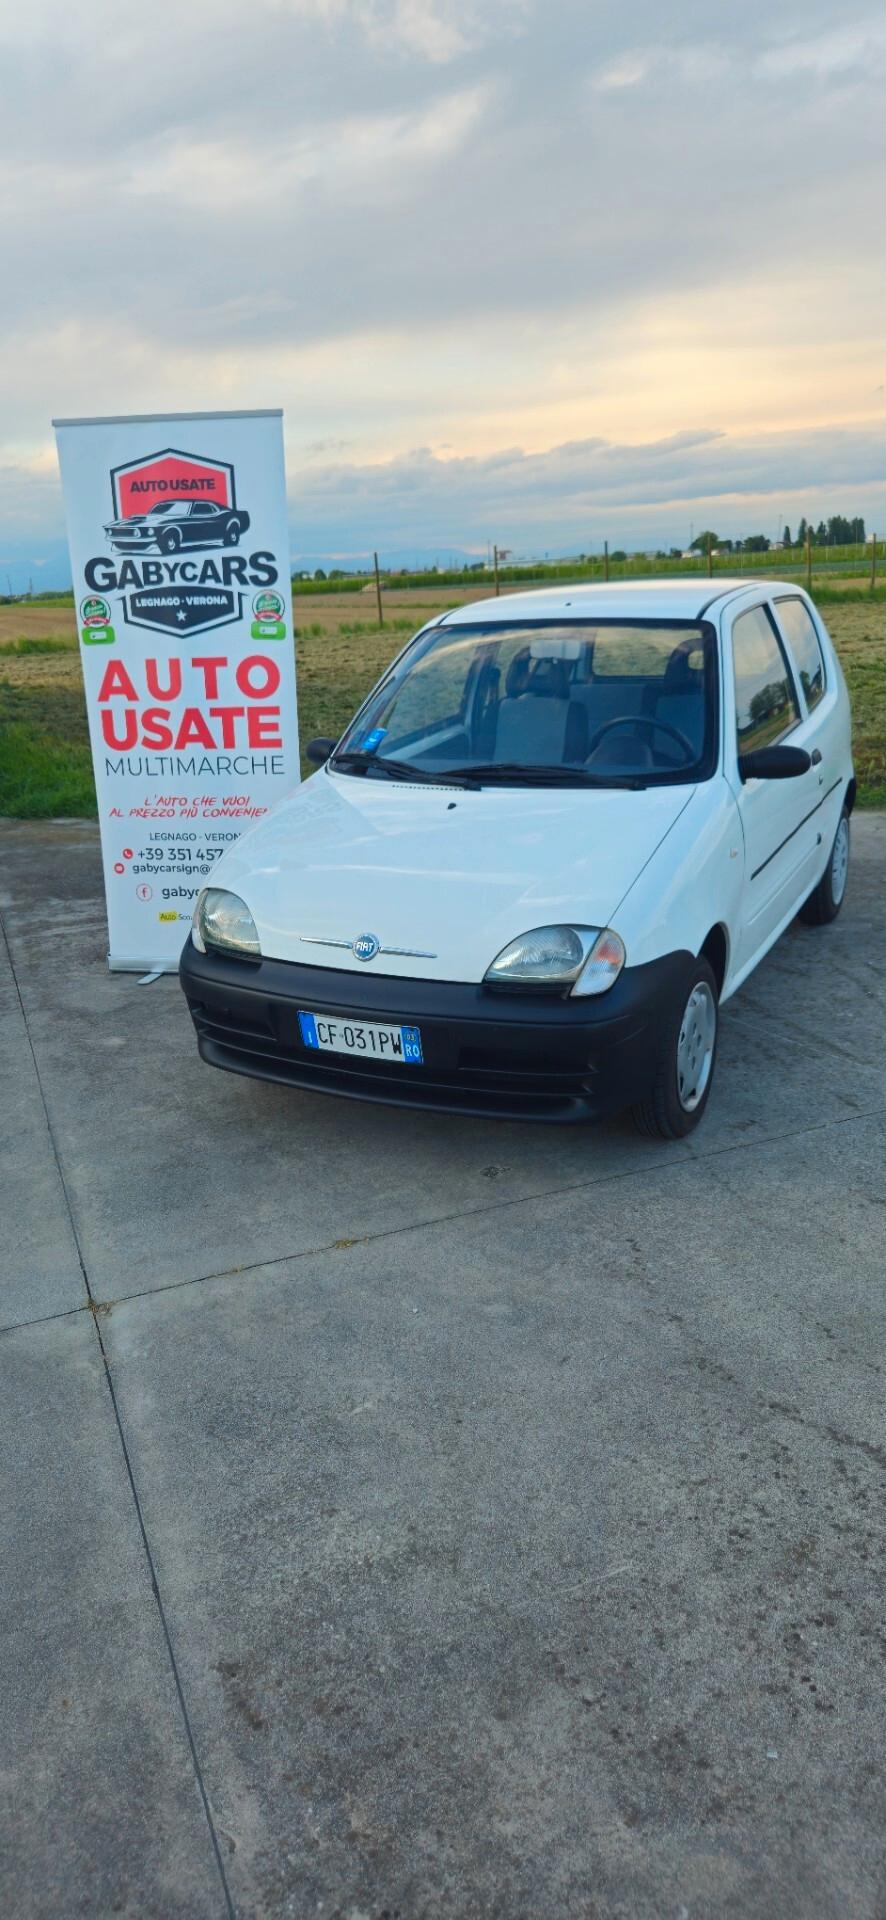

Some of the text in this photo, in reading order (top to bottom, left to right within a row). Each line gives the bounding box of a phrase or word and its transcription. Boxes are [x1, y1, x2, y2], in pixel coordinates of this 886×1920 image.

[130, 478, 216, 493] AUTO USATE
[84, 551, 279, 593] GABYCARS
[135, 597, 180, 608] LEGNAGO
[186, 595, 228, 606] VERONA
[97, 655, 281, 702] AUTO
[101, 706, 283, 751] USATE
[105, 755, 285, 776] MULTIMARCHE
[144, 795, 250, 806] L'AUTO CHE VUOI
[109, 808, 123, 817] AL
[129, 808, 175, 817] PREZZO
[180, 807, 198, 818] PIÙ
[149, 832, 197, 841] LEGNAGO
[137, 848, 223, 861] +39 351 457
[132, 863, 212, 875] gabycarsign@
[355, 941, 374, 952] FIAT
[317, 1022, 403, 1055] CF 031PW
[405, 1043, 420, 1057] RO
